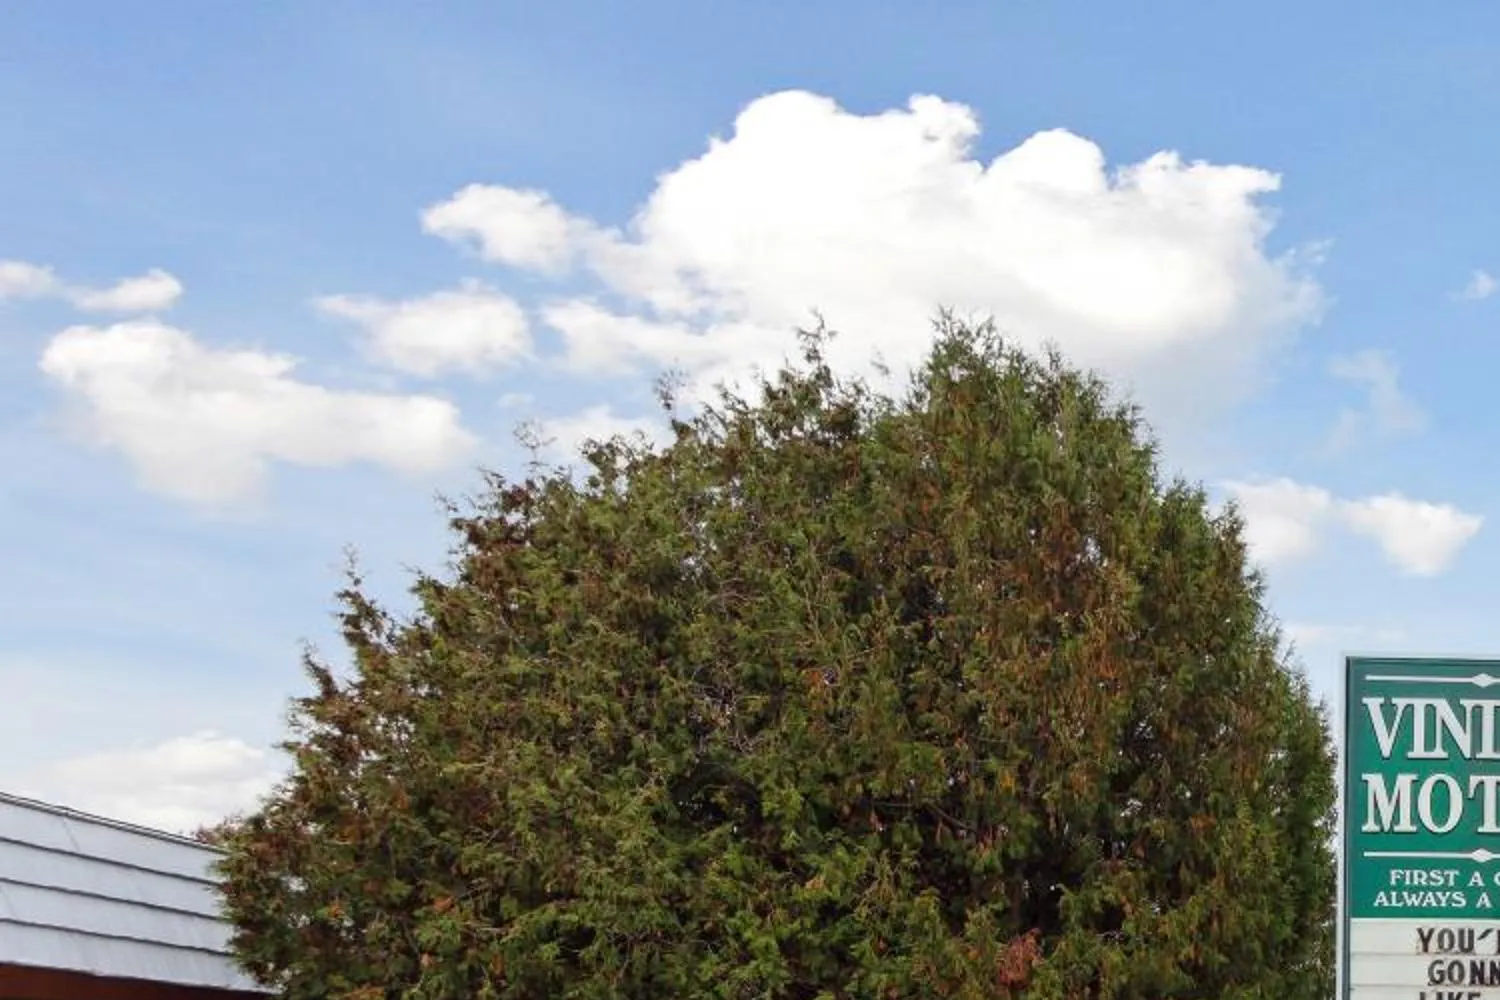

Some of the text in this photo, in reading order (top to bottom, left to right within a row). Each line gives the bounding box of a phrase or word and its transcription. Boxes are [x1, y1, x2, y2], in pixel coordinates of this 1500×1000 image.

[1389, 868, 1460, 887] FIRST
[1467, 870, 1486, 887] A
[1373, 890, 1467, 908] ALWAYS
[1475, 893, 1493, 909] A
